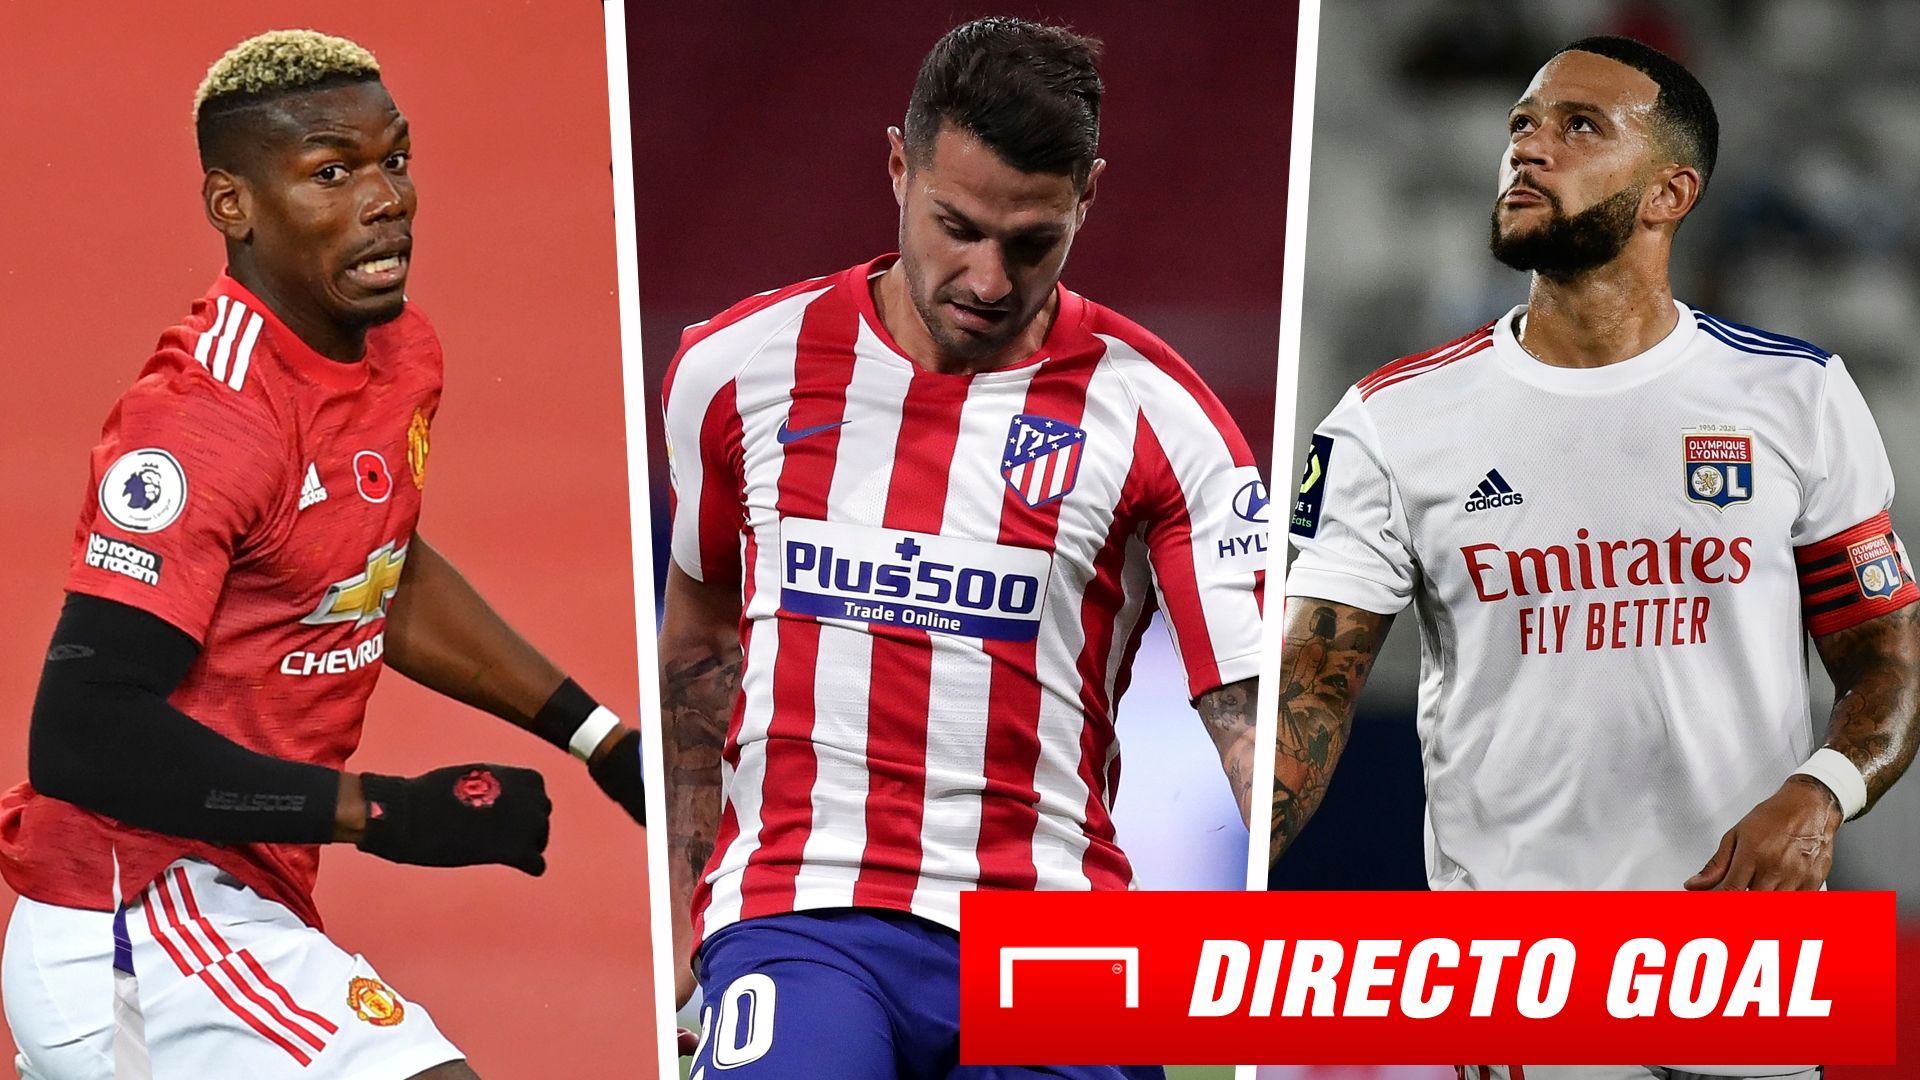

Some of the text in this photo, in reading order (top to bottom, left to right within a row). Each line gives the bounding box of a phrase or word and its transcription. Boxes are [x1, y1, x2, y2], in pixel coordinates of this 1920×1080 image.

[1689, 440, 1746, 450] OLYMPIQUE
[1690, 450, 1747, 460] LYONNAIS
[1464, 492, 1524, 513] adidas
[89, 532, 156, 569] No room
[1459, 527, 1752, 602] Emirates
[102, 556, 159, 586] racism
[786, 540, 1039, 614] Plus500
[844, 601, 961, 631] Trade Online
[1519, 597, 1711, 655] FLY BETTER
